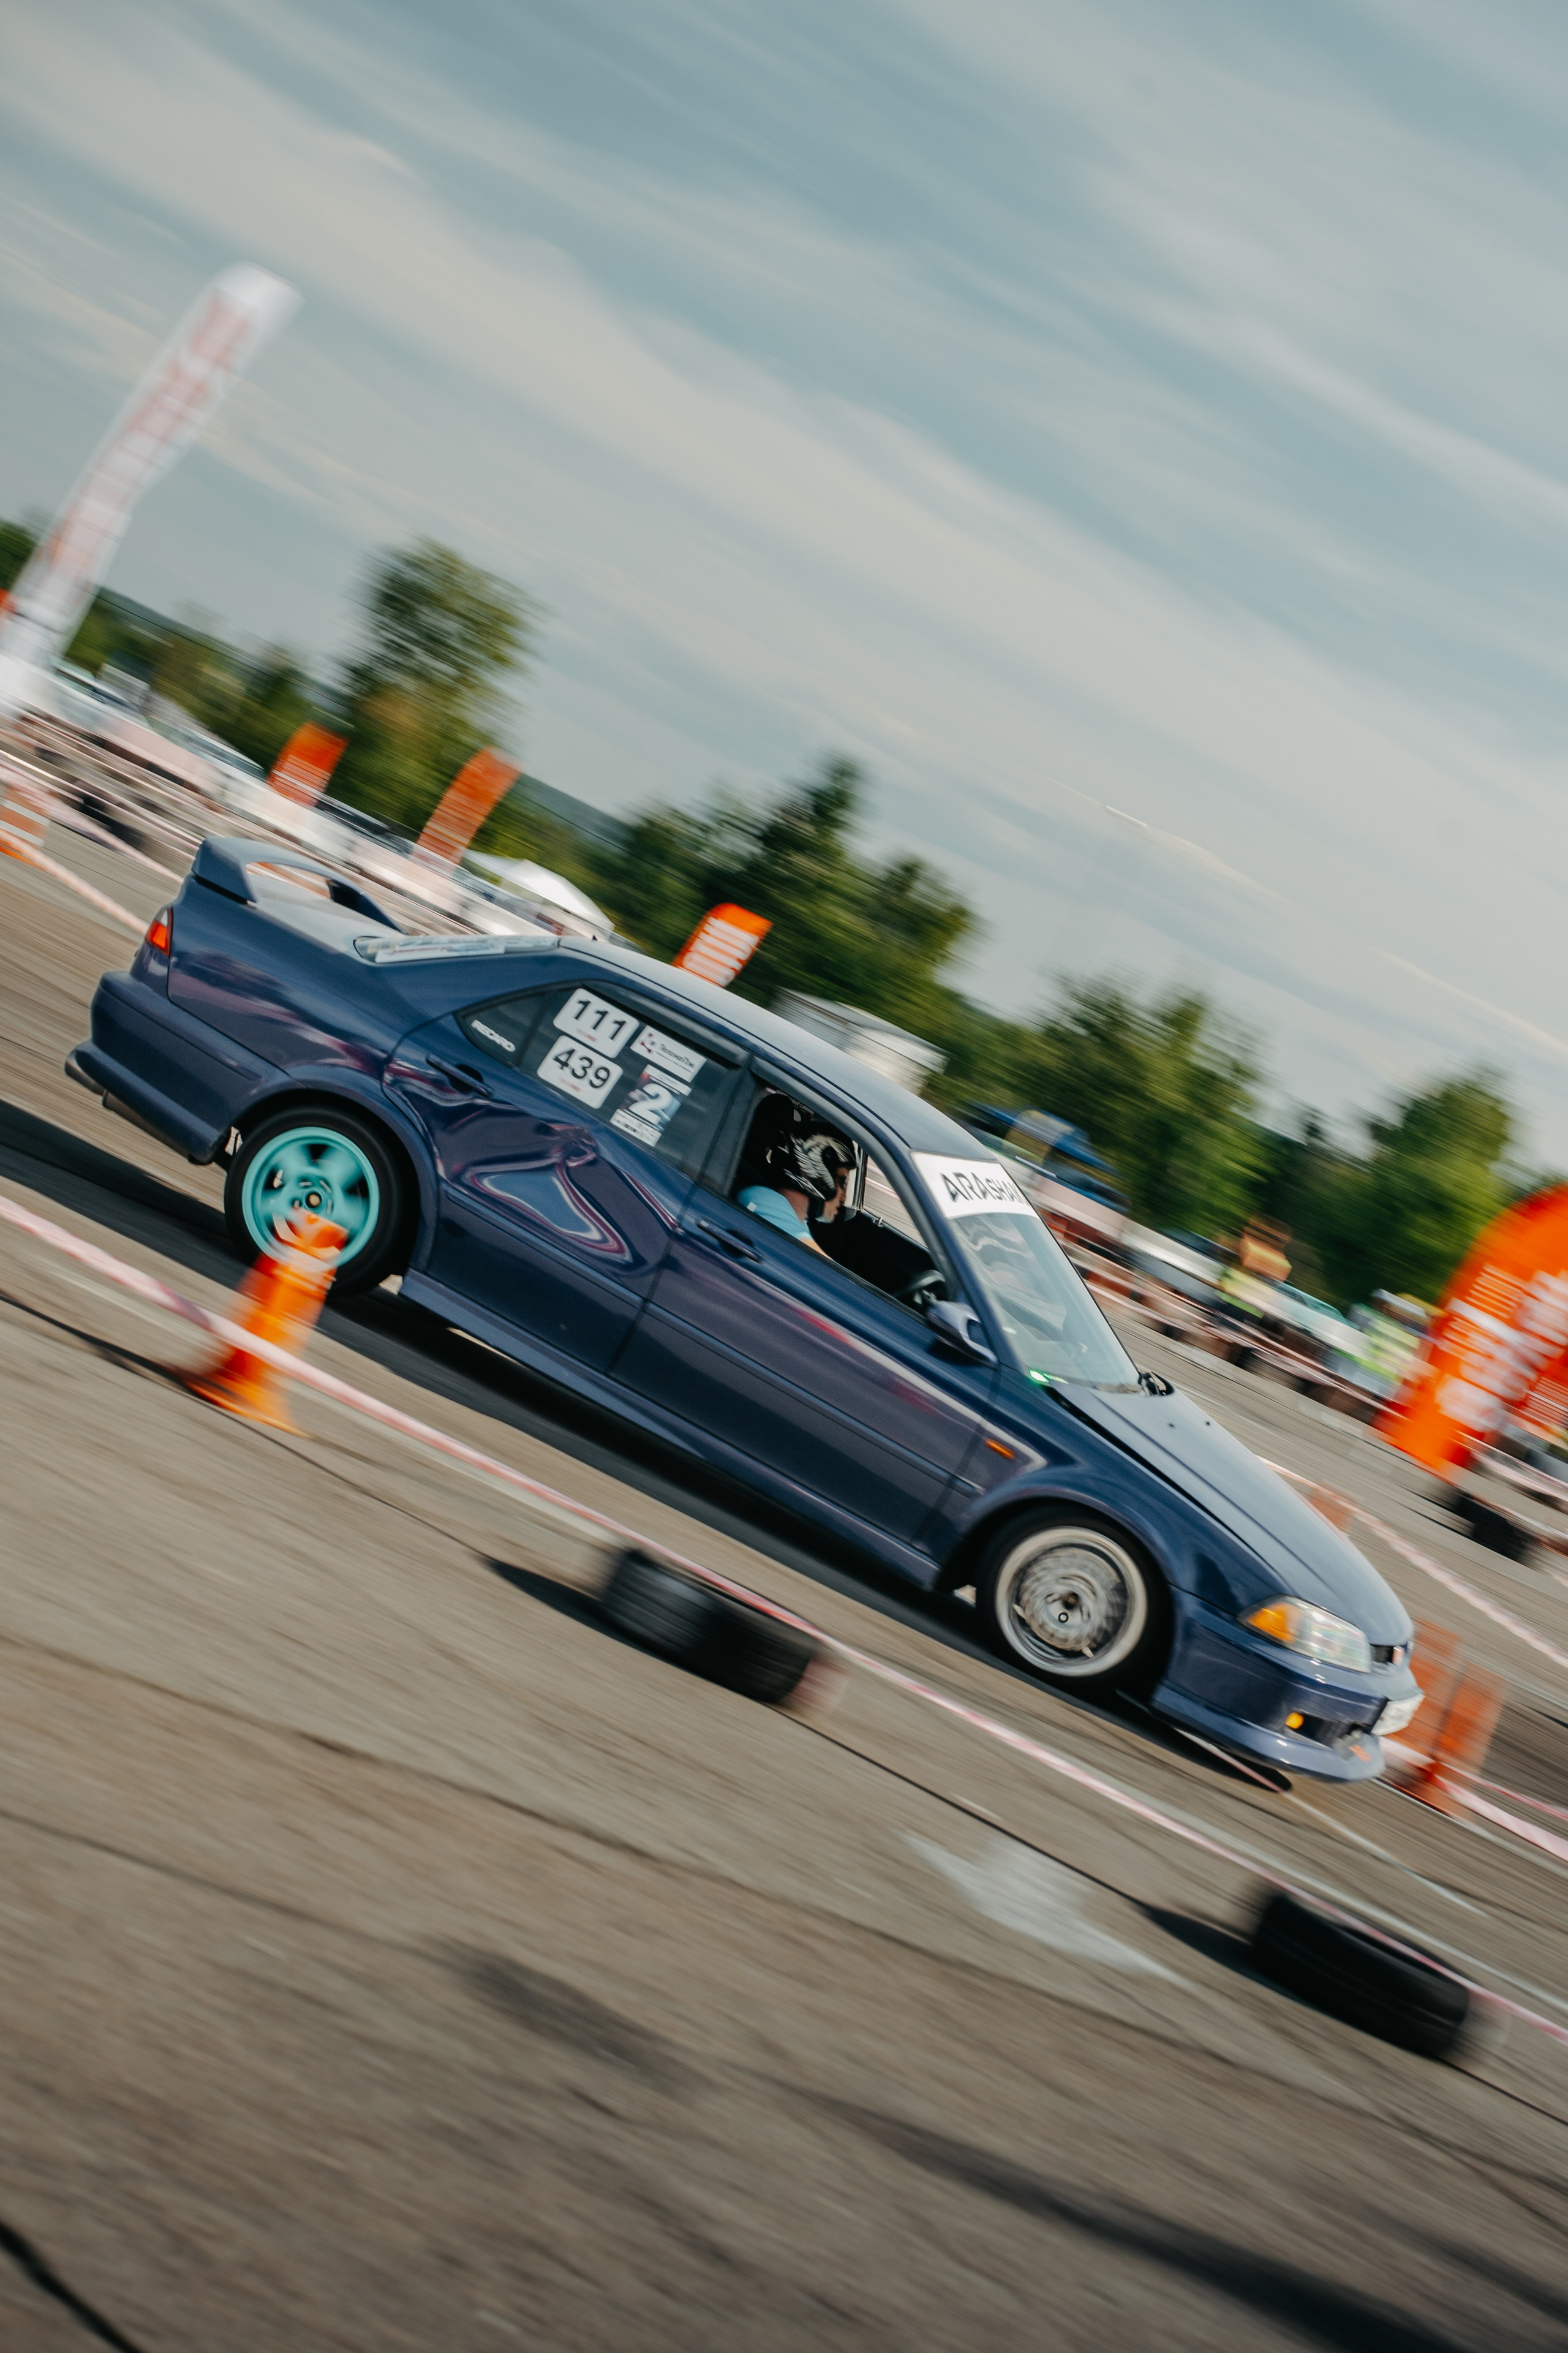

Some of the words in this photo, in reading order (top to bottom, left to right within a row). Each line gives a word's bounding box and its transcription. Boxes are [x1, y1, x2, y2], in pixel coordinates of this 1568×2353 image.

[573, 1000, 627, 1041] 111
[552, 1048, 611, 1089] 439
[628, 1082, 673, 1124] 2
